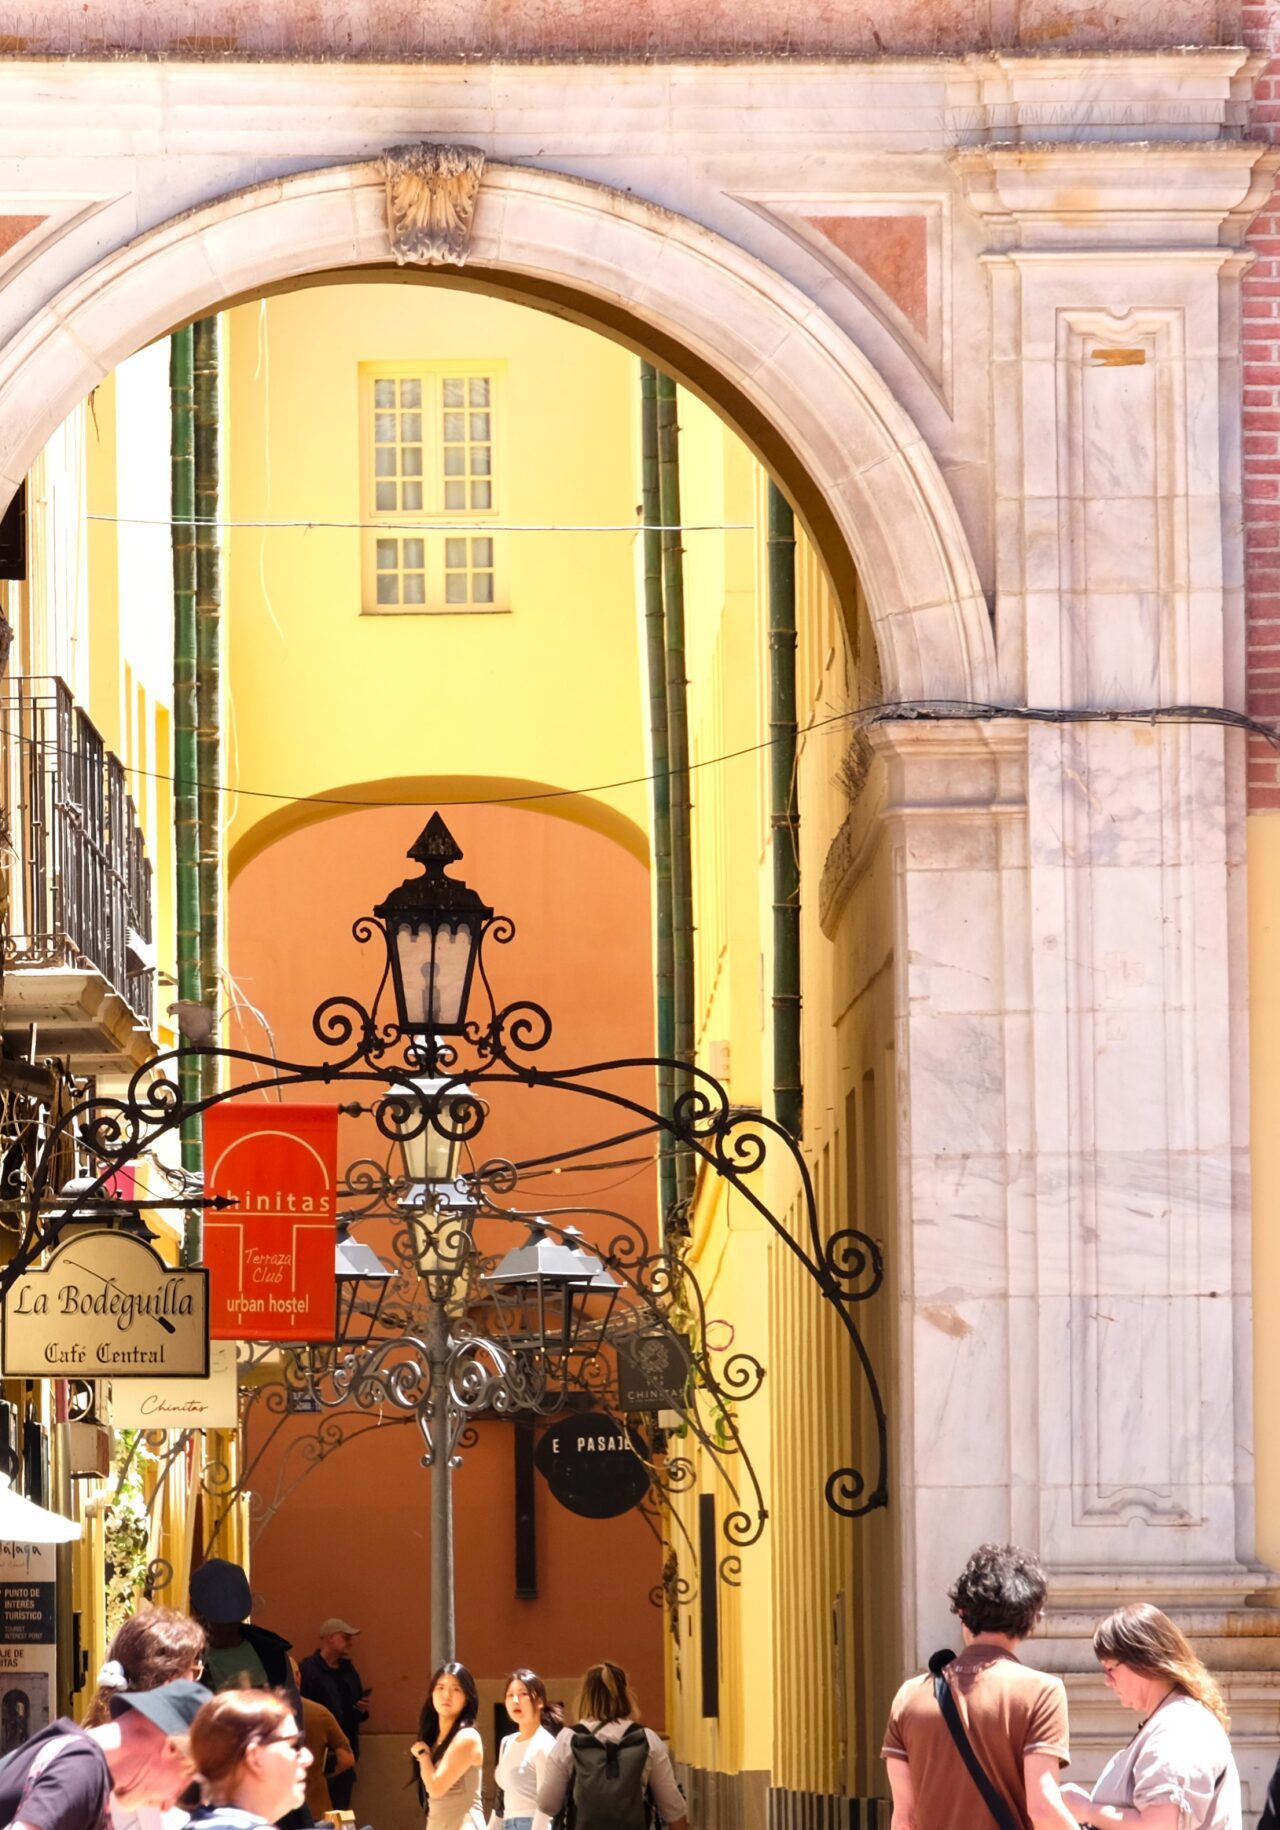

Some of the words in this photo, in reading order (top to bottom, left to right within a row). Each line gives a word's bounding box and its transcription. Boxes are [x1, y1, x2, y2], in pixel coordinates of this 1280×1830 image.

[244, 1247, 292, 1266] Terraza
[252, 1266, 283, 1283] Club
[13, 1285, 48, 1315] La
[57, 1278, 194, 1331] Bodeguilla
[226, 1292, 265, 1312] urban
[268, 1292, 309, 1312] hostel
[44, 1342, 87, 1364] Café
[96, 1342, 166, 1364] Central
[140, 1395, 209, 1415] Chinitas
[577, 1435, 632, 1453] PASAJE
[4, 1588, 29, 1598] PUNTO
[30, 1588, 40, 1598] DE
[4, 1598, 35, 1609] INTERÉS
[4, 1609, 42, 1621] TURÍSTICO
[14, 1649, 24, 1658] DE
